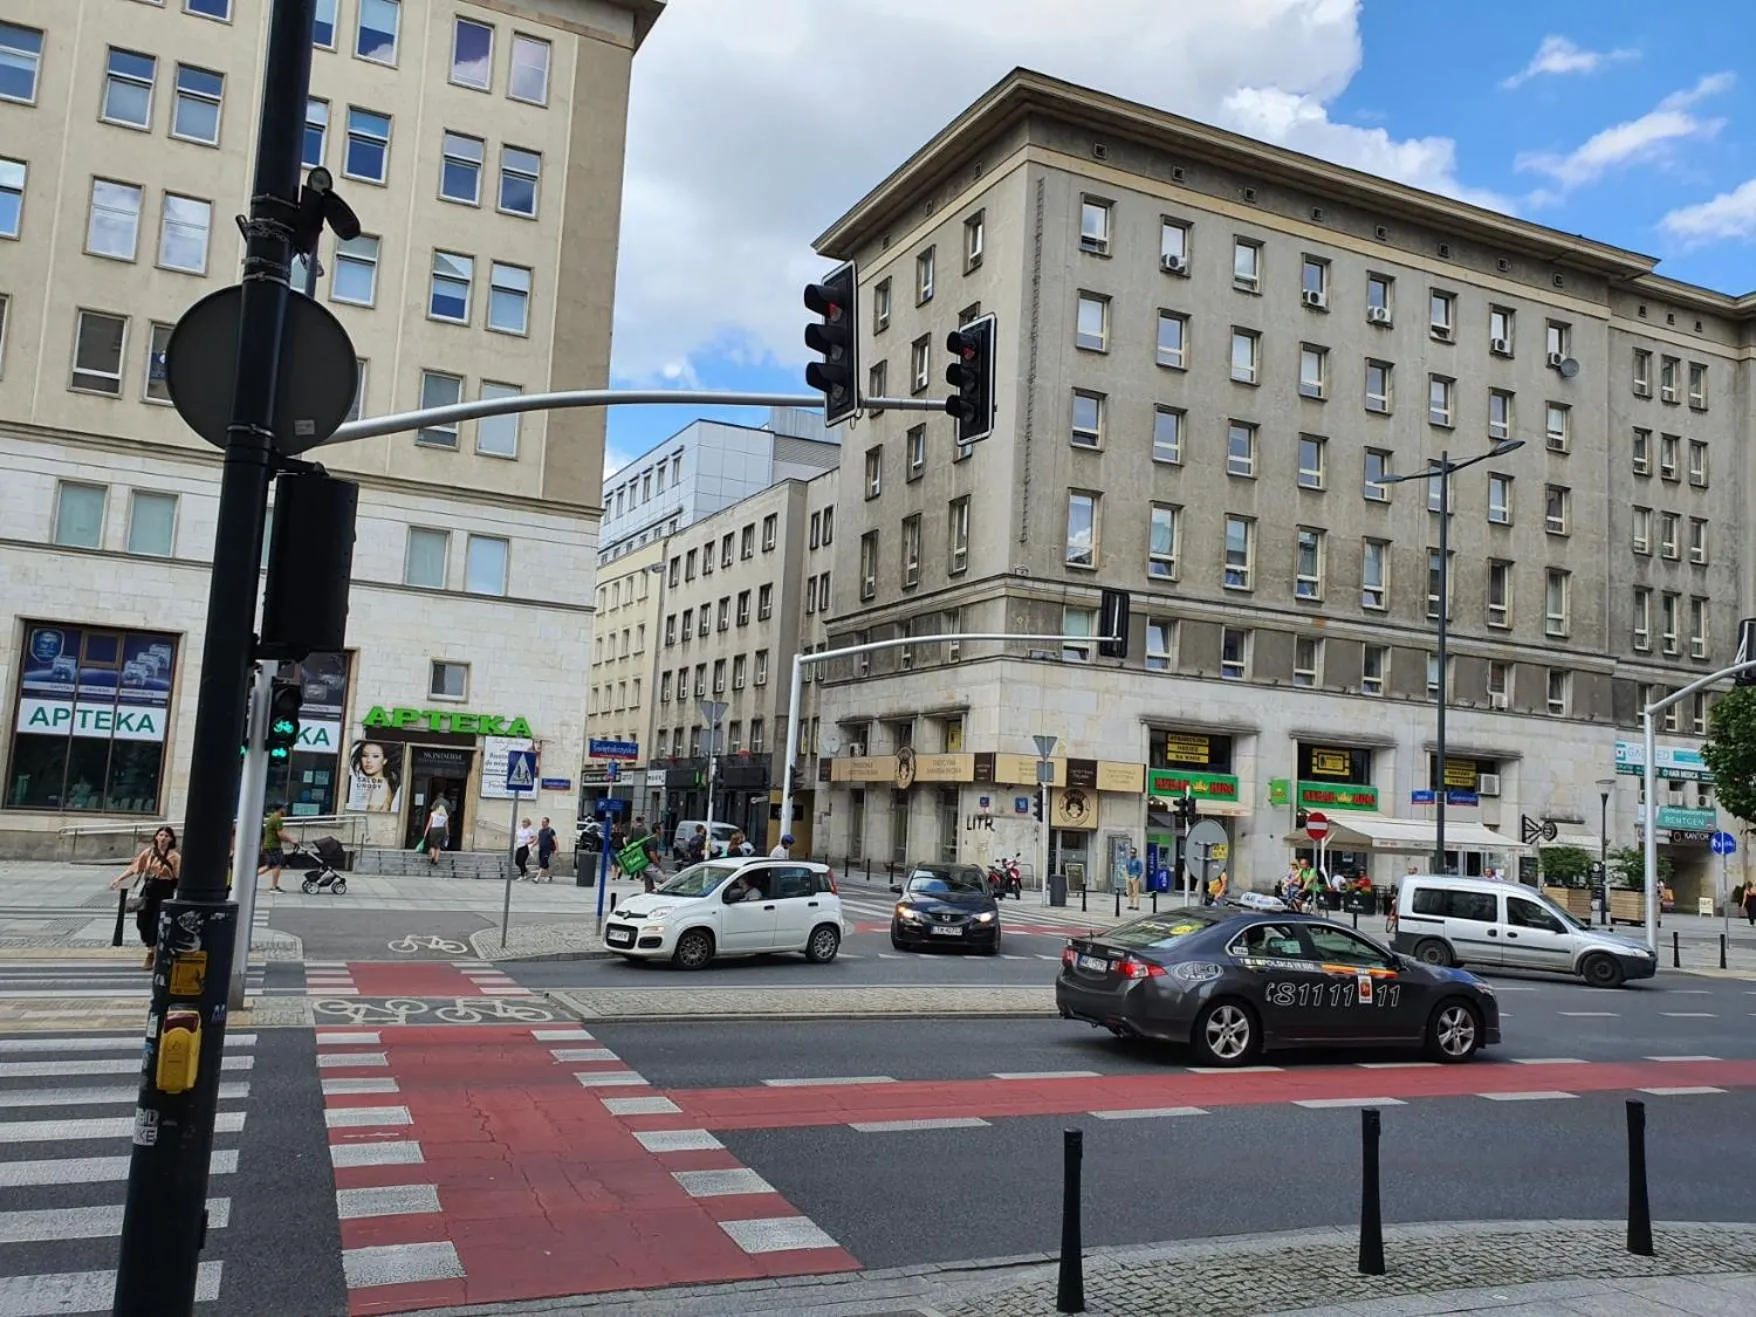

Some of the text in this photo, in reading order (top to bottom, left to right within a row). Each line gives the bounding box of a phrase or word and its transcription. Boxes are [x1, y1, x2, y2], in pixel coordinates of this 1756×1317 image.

[28, 706, 156, 734] APTEKA
[362, 705, 533, 738] APTEKA
[1665, 816, 1704, 826] RENTGEN
